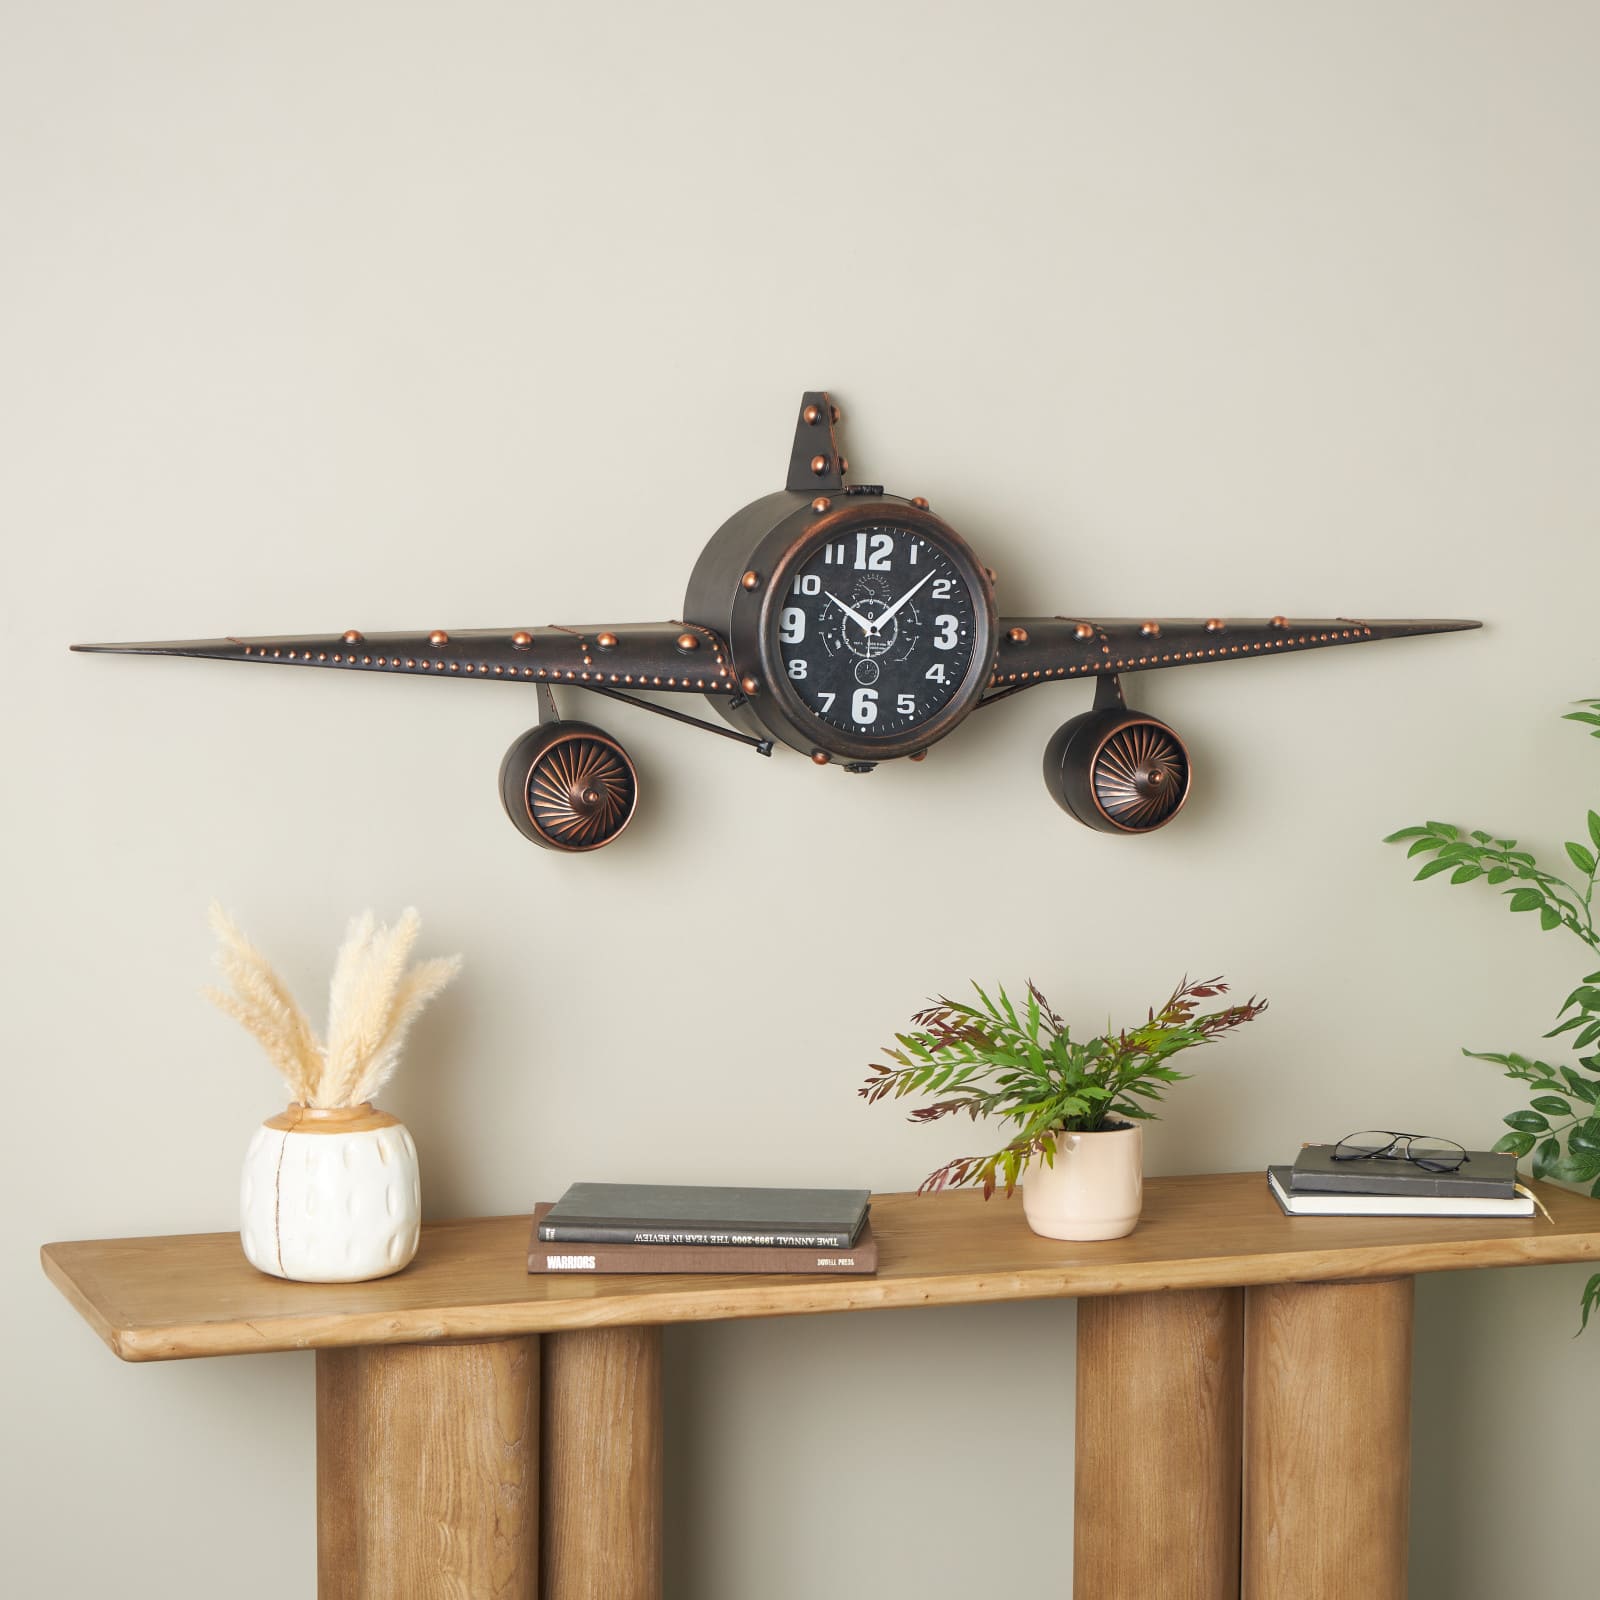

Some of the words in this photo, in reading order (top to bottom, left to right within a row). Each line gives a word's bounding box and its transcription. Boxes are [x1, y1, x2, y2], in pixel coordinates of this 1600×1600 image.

[825, 543, 845, 565] 11
[854, 533, 894, 571] 12
[909, 544, 918, 565] 1
[793, 574, 821, 596] 10
[932, 578, 951, 599] 2
[779, 607, 806, 644] 9
[933, 614, 959, 650] 3
[788, 659, 808, 680] 8
[925, 663, 946, 684] 4
[817, 692, 836, 713] 7
[851, 688, 879, 724] 6
[896, 694, 916, 714] 5
[634, 1233, 670, 1242] REVIEW
[672, 1233, 683, 1243] IN
[685, 1234, 708, 1243] YEAR
[711, 1235, 730, 1244] THE
[732, 1235, 774, 1245] 1999-2000
[777, 1236, 815, 1246] ANNUAL
[817, 1237, 839, 1246] TIME
[546, 1255, 596, 1269] WARRIORS
